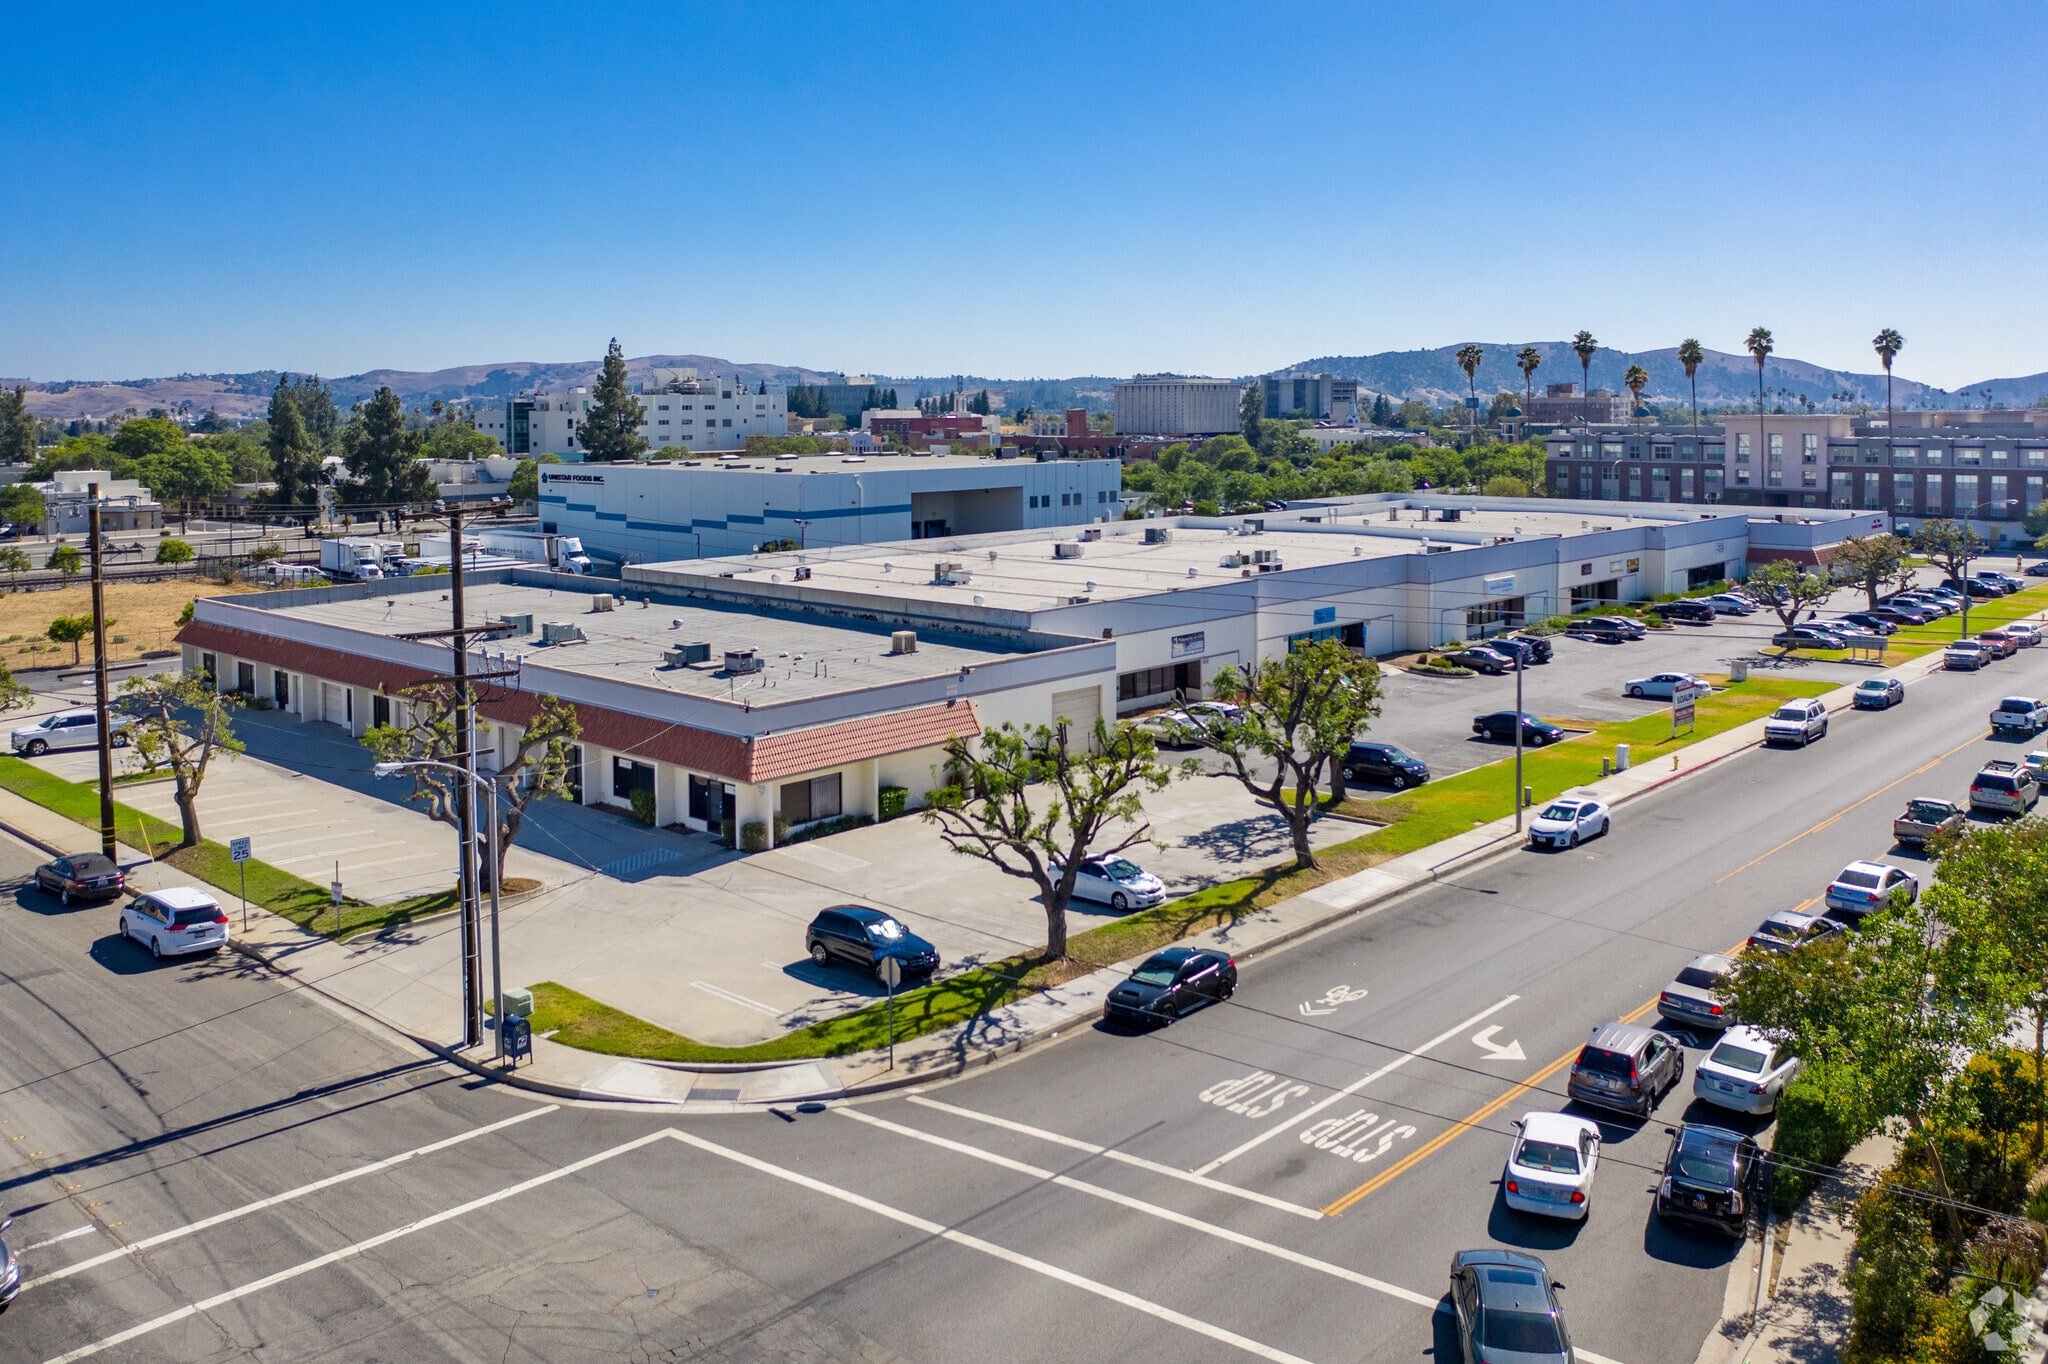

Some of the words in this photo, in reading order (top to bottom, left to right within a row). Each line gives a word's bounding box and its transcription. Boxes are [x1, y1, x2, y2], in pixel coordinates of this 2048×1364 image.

[232, 839, 249, 847] SPEED
[233, 849, 249, 860] 25
[1199, 1070, 1310, 1119] STOP
[1299, 1108, 1417, 1163] STOP
